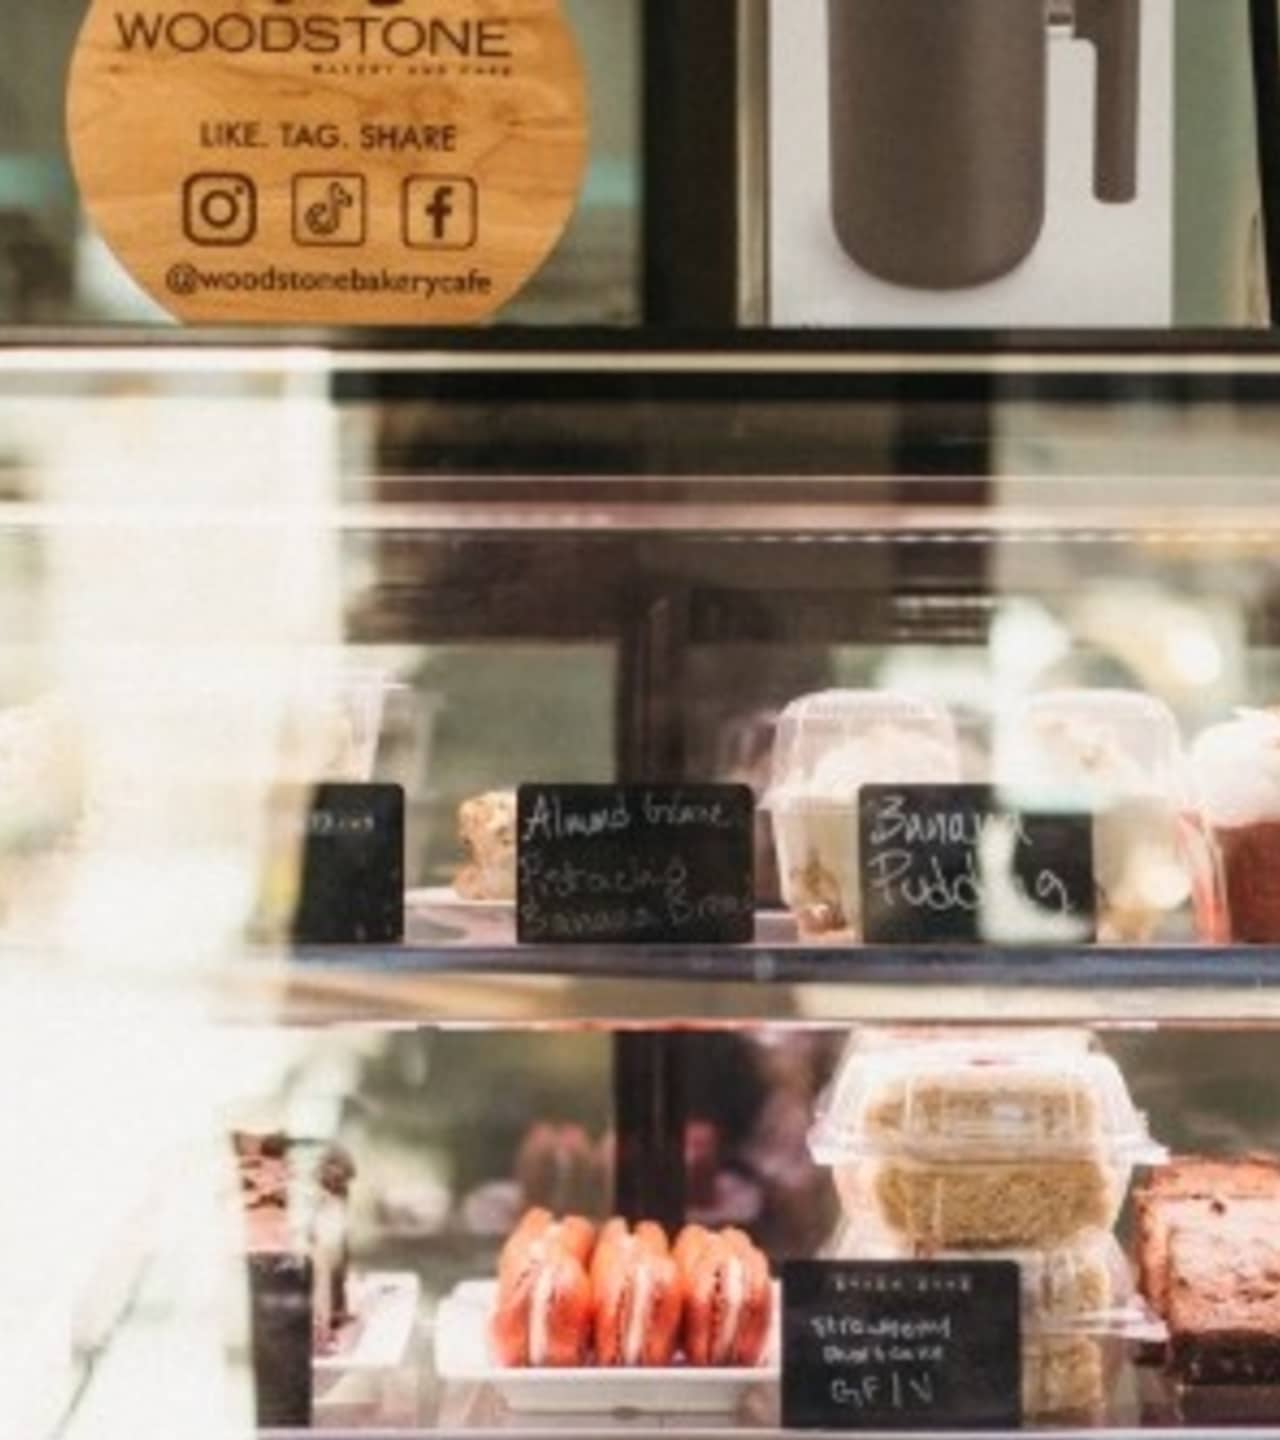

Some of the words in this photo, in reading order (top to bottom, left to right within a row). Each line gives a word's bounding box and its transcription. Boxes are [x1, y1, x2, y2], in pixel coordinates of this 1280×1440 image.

[116, 13, 513, 58] WOODSTONE
[200, 121, 267, 148] LIKE.
[282, 122, 349, 151] TAG.
[361, 125, 457, 152] SHARE
[166, 263, 493, 298] @woodstonebakerycafe
[867, 849, 1070, 918] Puddg
